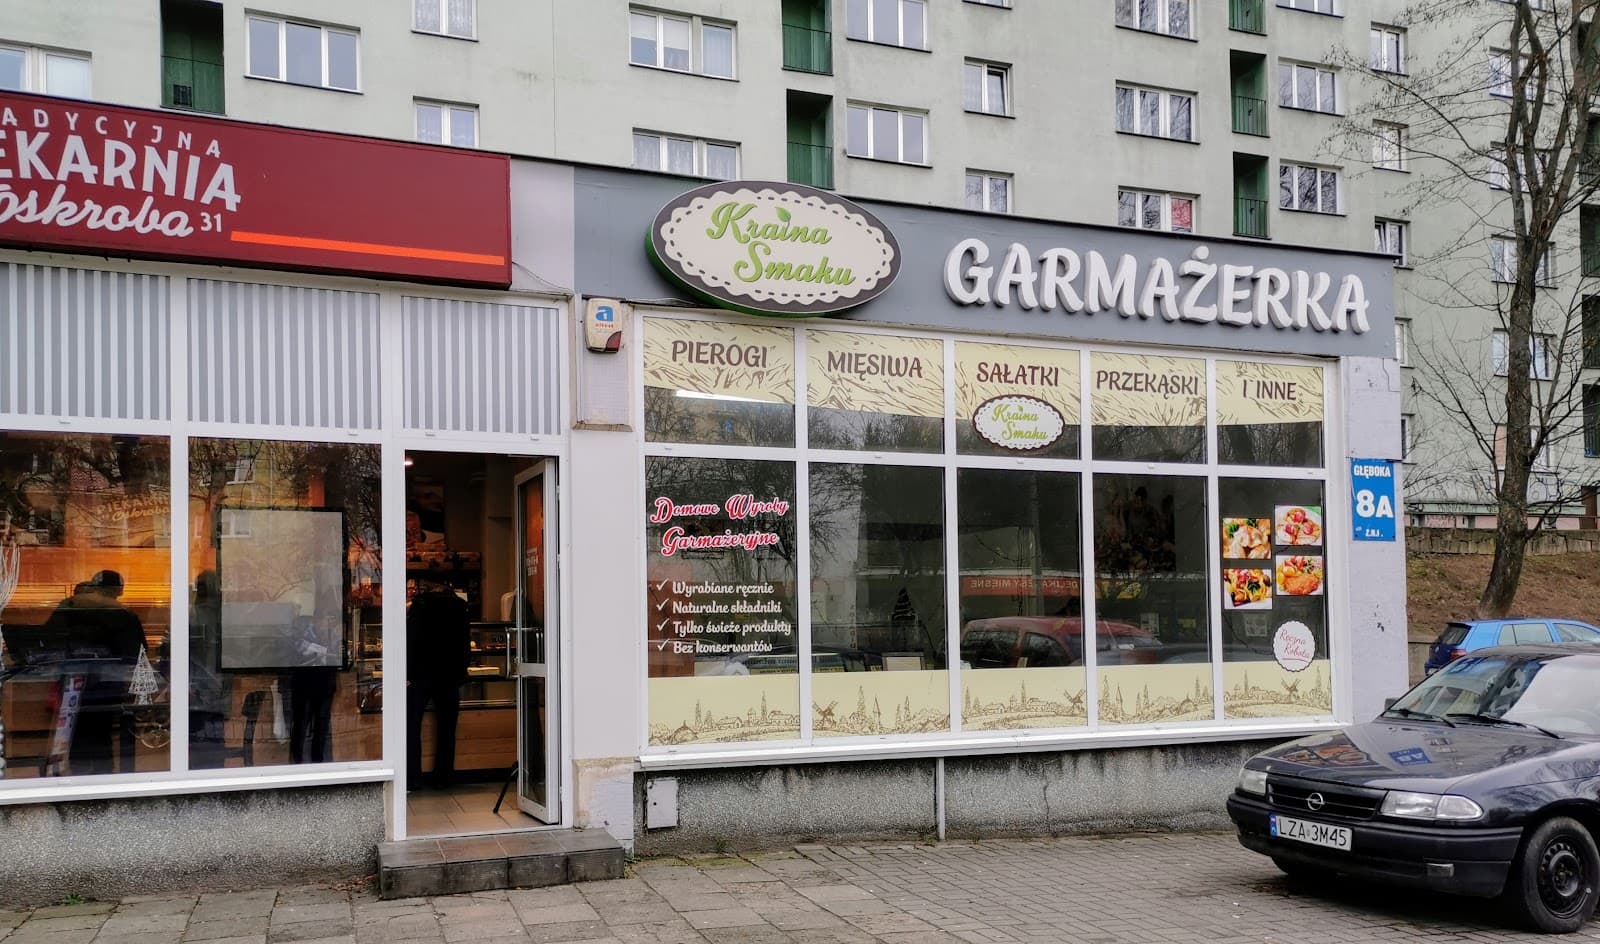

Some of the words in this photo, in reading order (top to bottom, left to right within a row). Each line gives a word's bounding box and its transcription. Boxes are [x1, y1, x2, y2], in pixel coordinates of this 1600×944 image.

[200, 211, 222, 233] 31
[706, 201, 832, 244] Kraina
[733, 241, 856, 285] Smaku
[944, 238, 1371, 333] GARMAŻERKA
[671, 340, 768, 369] PIEROGI
[828, 351, 924, 381] MIĘSIWA
[976, 362, 1060, 387] SAŁATKI
[1096, 370, 1199, 400] PRZEKĄSKI
[1243, 379, 1248, 398] I
[1256, 381, 1297, 401] INNE
[992, 404, 1039, 423] Kraina
[1002, 421, 1049, 440] Smaku
[1353, 464, 1391, 480] GŁĘBOKA
[650, 496, 720, 523] Domowe
[725, 494, 789, 519] Wyroby
[1356, 489, 1394, 518] 8A
[661, 526, 779, 556] Garmażeryjne
[672, 581, 734, 597] Wyrabiane
[735, 582, 774, 597] ręcznie
[672, 601, 729, 614] Naturalne
[730, 600, 782, 613] składniki
[673, 620, 704, 637] Tylko
[706, 621, 741, 634] świeże
[742, 619, 792, 635] produkty
[673, 641, 694, 654] Bez
[695, 639, 773, 653] konserwantów
[1279, 818, 1306, 840] LZA
[1312, 824, 1347, 847] 3M45
